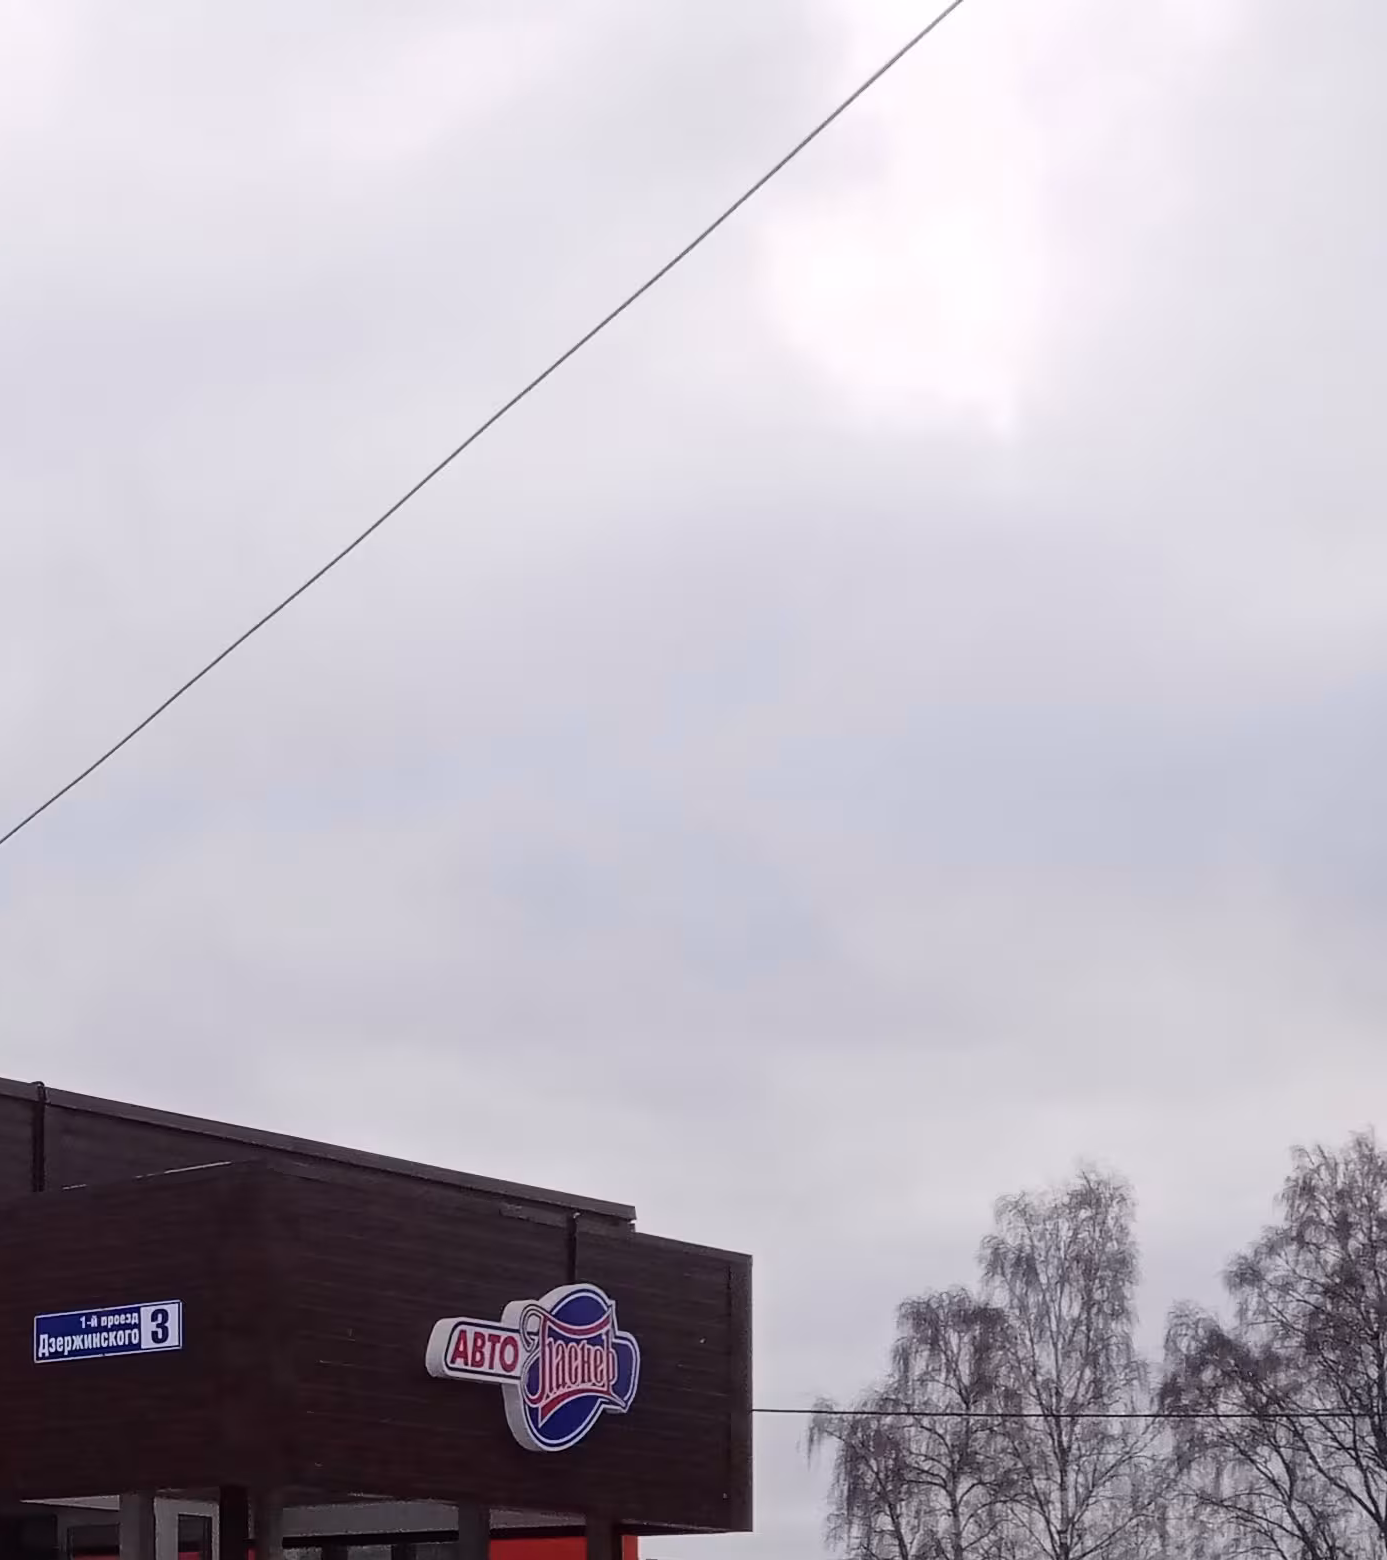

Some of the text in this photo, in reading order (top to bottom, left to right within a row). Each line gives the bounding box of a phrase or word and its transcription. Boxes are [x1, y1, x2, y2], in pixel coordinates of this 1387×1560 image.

[79, 1312, 139, 1329] 1-й проезд
[150, 1308, 170, 1344] 3
[38, 1328, 140, 1358] Дзержинского
[449, 1328, 520, 1373] АВТО
